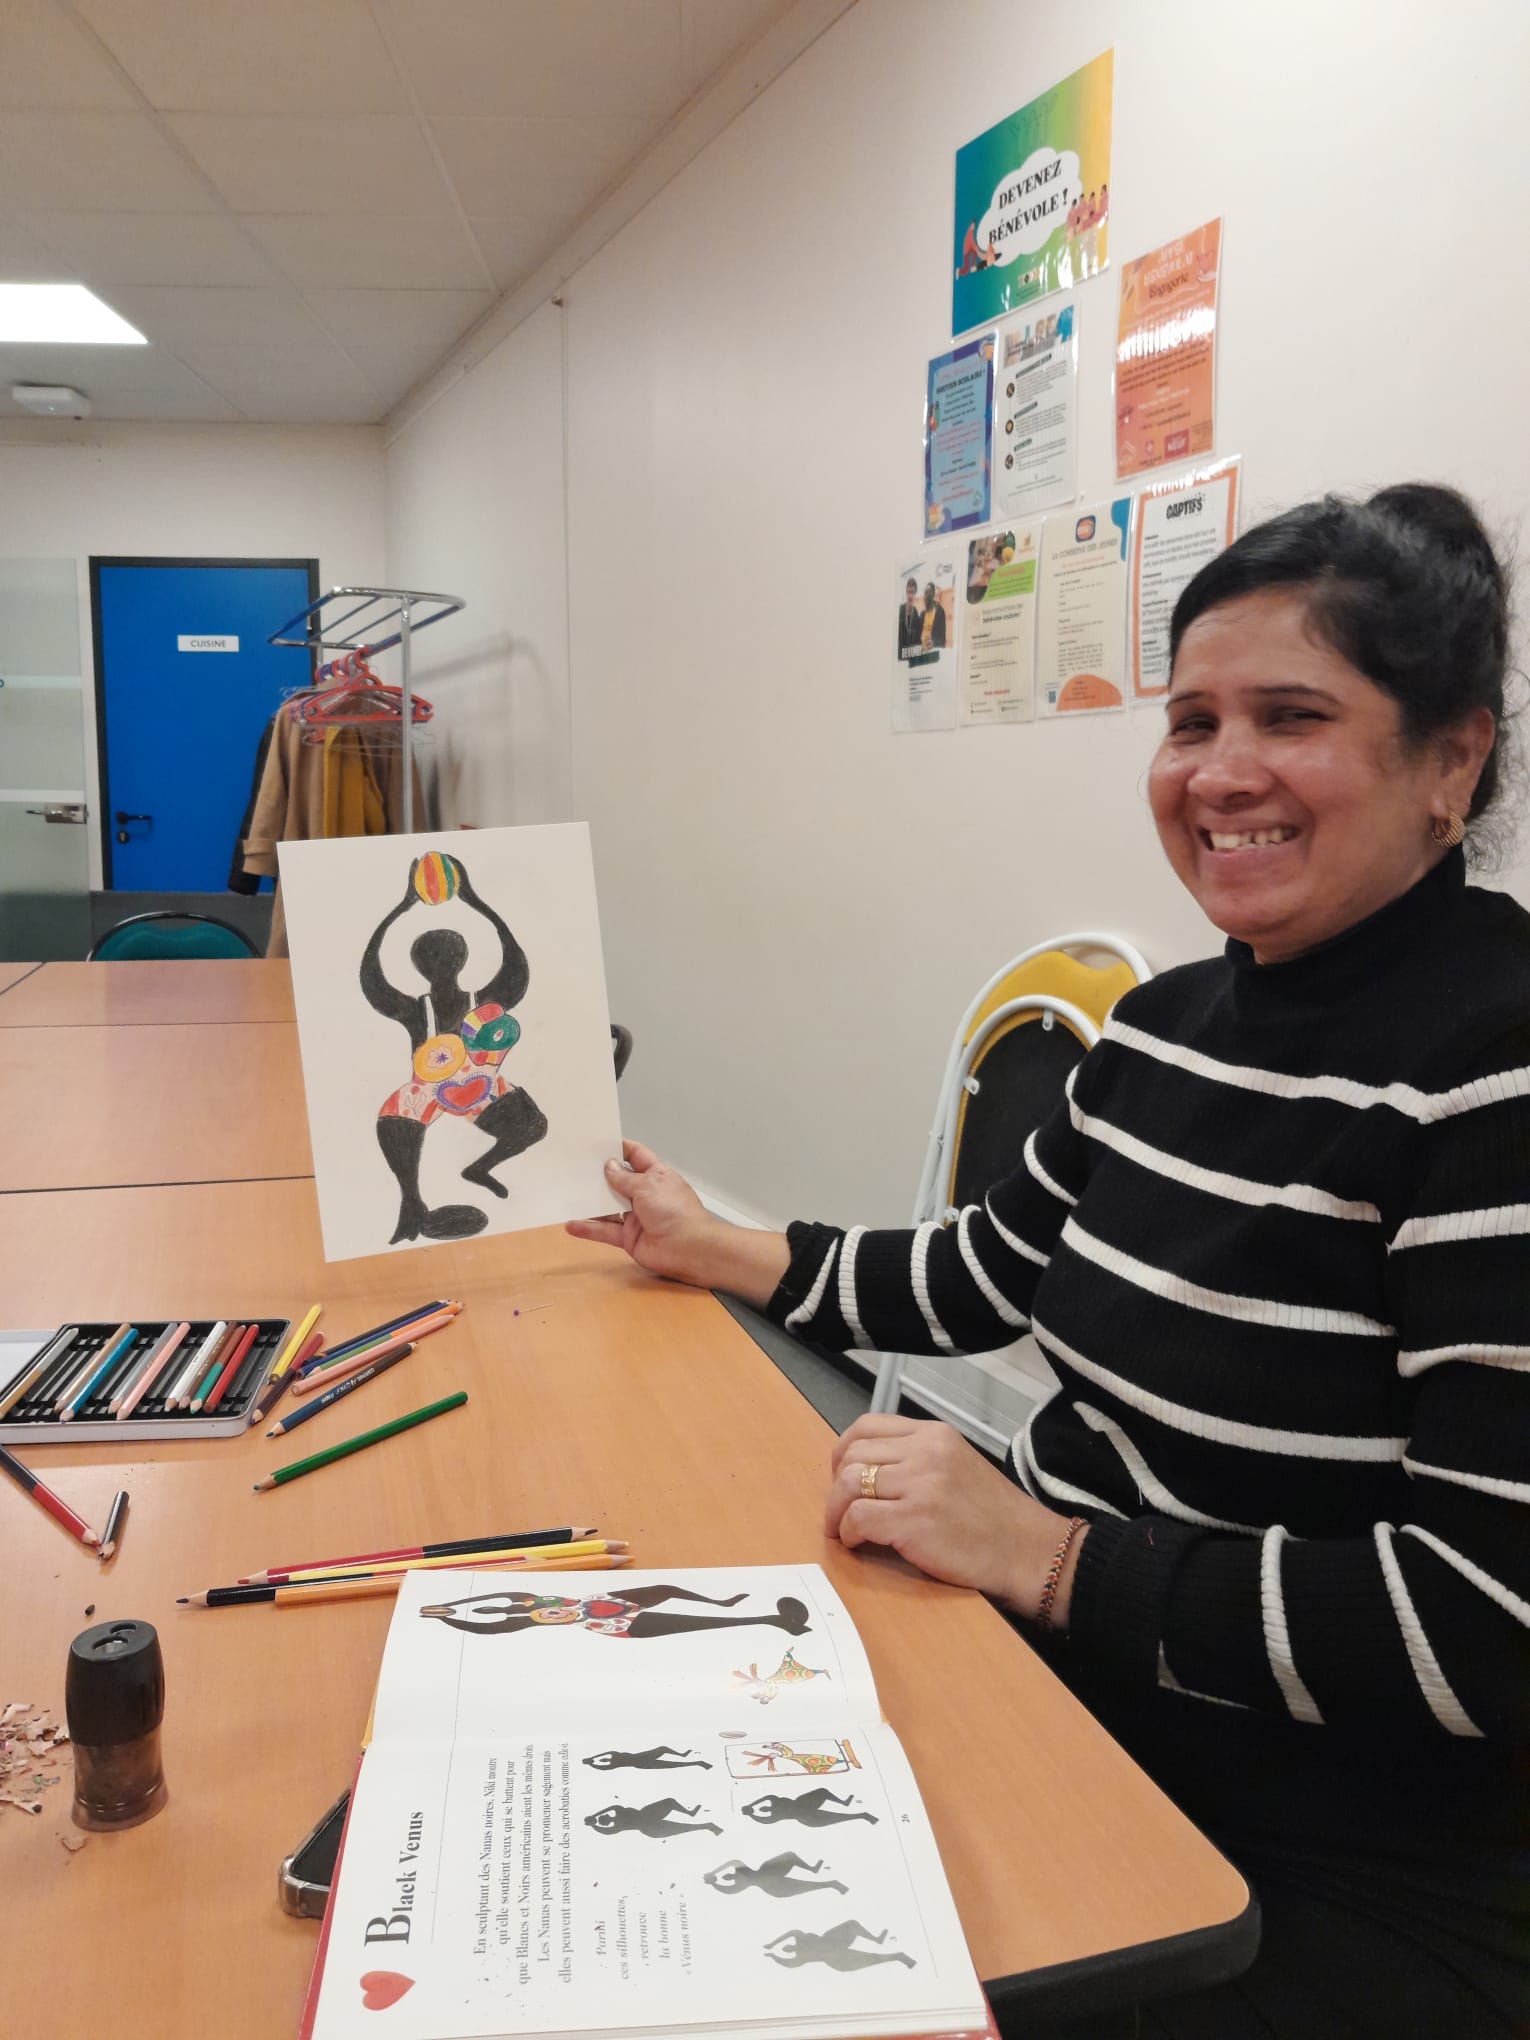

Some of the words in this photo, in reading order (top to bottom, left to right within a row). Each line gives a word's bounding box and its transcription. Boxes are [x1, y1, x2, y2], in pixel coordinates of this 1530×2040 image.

[999, 158, 1062, 210] DEVENEZ
[988, 193, 1060, 243] BÉNÉVOLE
[1062, 187, 1068, 206] !
[190, 639, 226, 649] CUISINE
[507, 1761, 518, 1776] pour
[541, 1764, 554, 1797] sagement
[560, 1761, 570, 1785] comme
[483, 1781, 496, 1797] Niki
[501, 1777, 514, 1804] battent
[521, 1783, 533, 1795] les
[504, 1806, 513, 1815] se
[520, 1797, 533, 1818] aient
[542, 1799, 554, 1842] promener
[558, 1787, 571, 1830] acrobaties
[901, 1813, 911, 1823] 26
[501, 1818, 516, 1833] qui
[479, 1831, 493, 1860] Nanas
[503, 1835, 512, 1858] ceux
[519, 1819, 532, 1872] américains
[542, 1845, 551, 1856] se
[558, 1832, 571, 1849] des
[478, 1863, 490, 1881] des
[558, 1852, 571, 1875] faire
[364, 1871, 417, 1946] Black
[399, 1811, 424, 1864] Venus
[499, 1862, 511, 1904] soutient
[518, 1874, 531, 1904] Noirs
[541, 1859, 554, 1901] peuvent
[559, 1878, 571, 1904] aussi
[475, 1884, 491, 1935] sculptant
[519, 1907, 530, 1918] et
[537, 1903, 551, 1939] Nanas
[677, 1902, 689, 1930] noire
[515, 1921, 529, 1958] Blancs
[560, 1908, 575, 1953] peuvent
[595, 1920, 608, 1955] Parmi
[639, 1912, 649, 1959] retrouve
[658, 1911, 669, 1943] bonne
[473, 1938, 487, 1954] En
[537, 1941, 551, 1962] Les
[659, 1947, 670, 1959] la
[519, 1962, 531, 1984] que
[558, 1956, 572, 1983] elles
